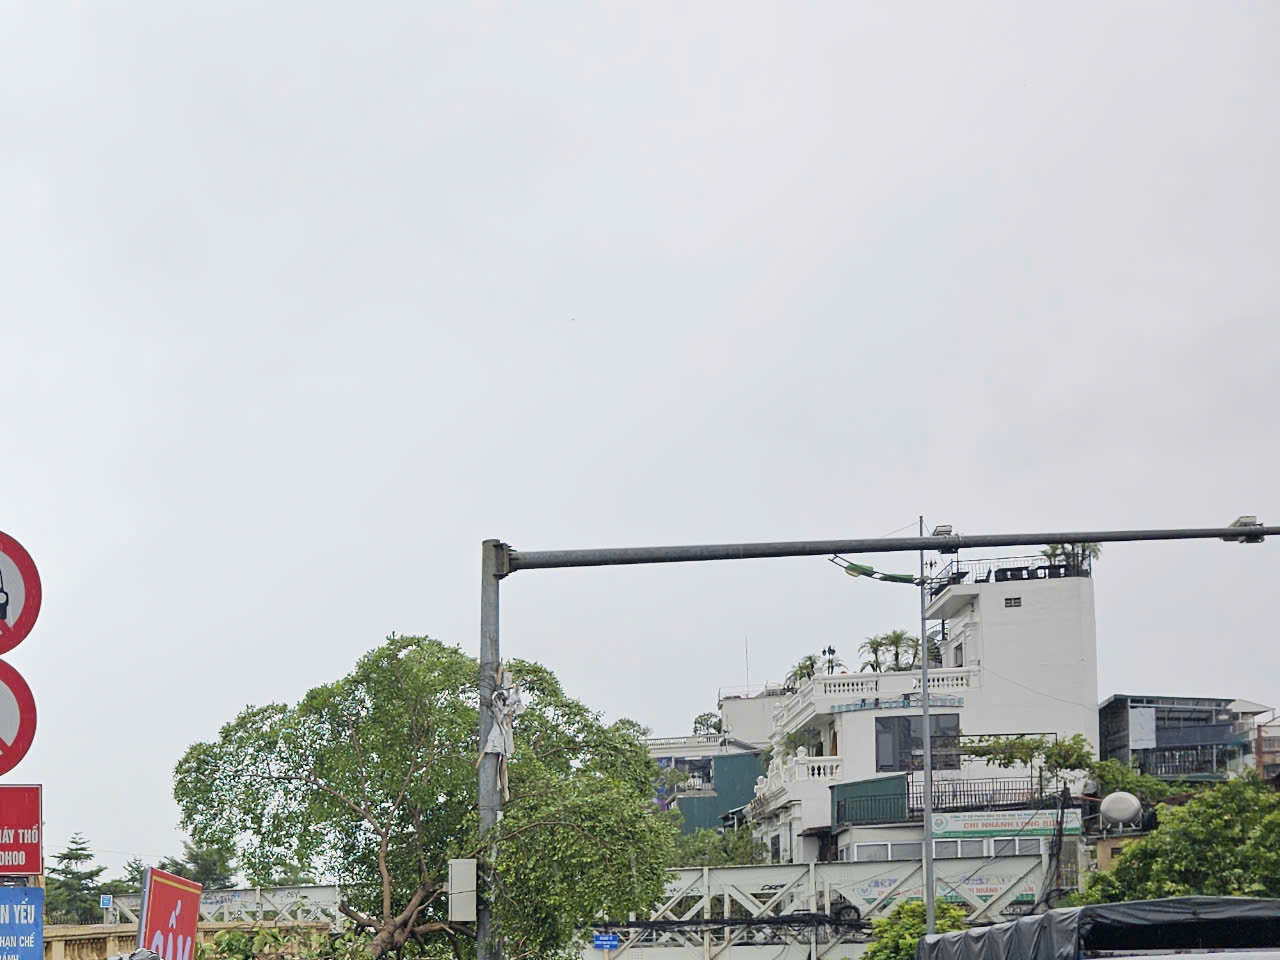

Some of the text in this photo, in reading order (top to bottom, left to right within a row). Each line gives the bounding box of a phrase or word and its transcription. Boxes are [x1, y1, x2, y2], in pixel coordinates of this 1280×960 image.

[13, 898, 35, 924] YẾU
[0, 936, 17, 950] HẠN
[19, 931, 36, 948] CHẾ
